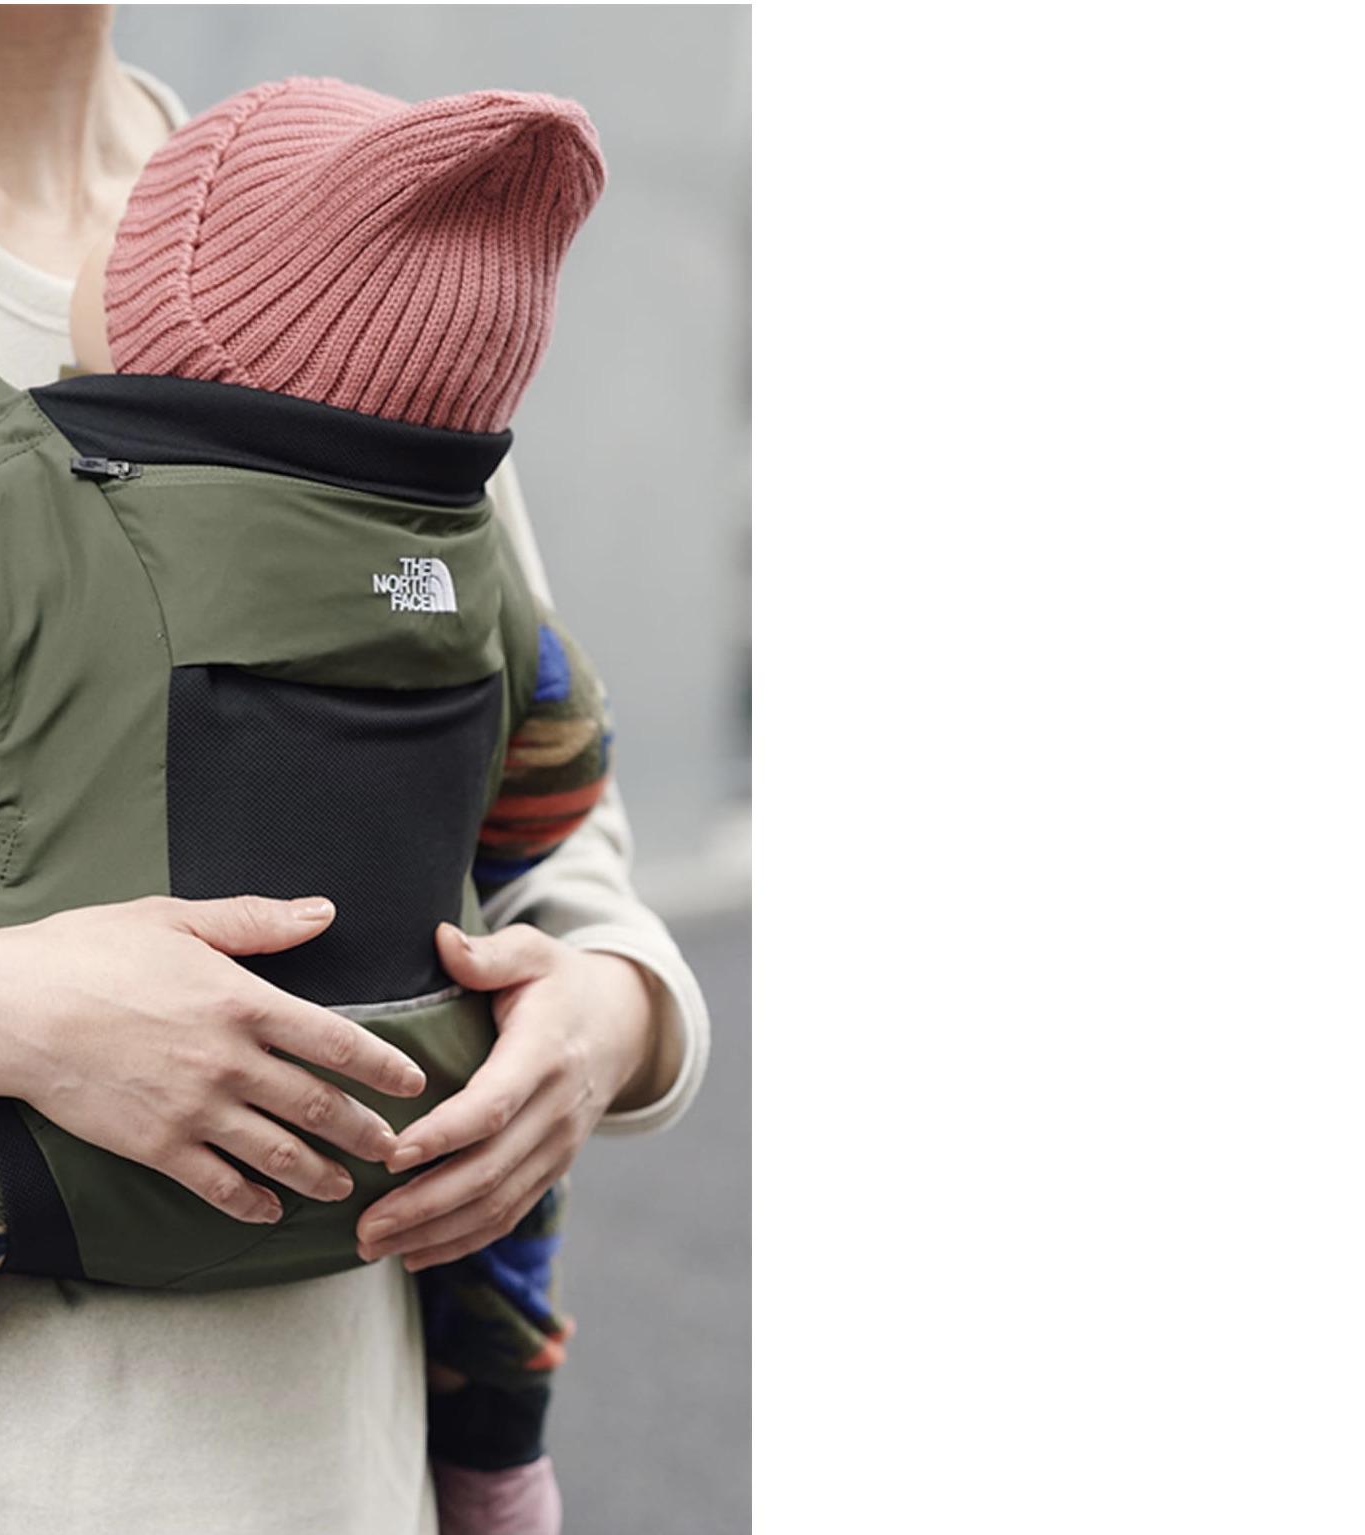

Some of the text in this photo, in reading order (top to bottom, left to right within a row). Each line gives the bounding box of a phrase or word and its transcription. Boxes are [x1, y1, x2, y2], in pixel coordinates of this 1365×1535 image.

[399, 557, 432, 576] THE
[373, 573, 429, 594] NORTH
[391, 592, 431, 612] FACE
